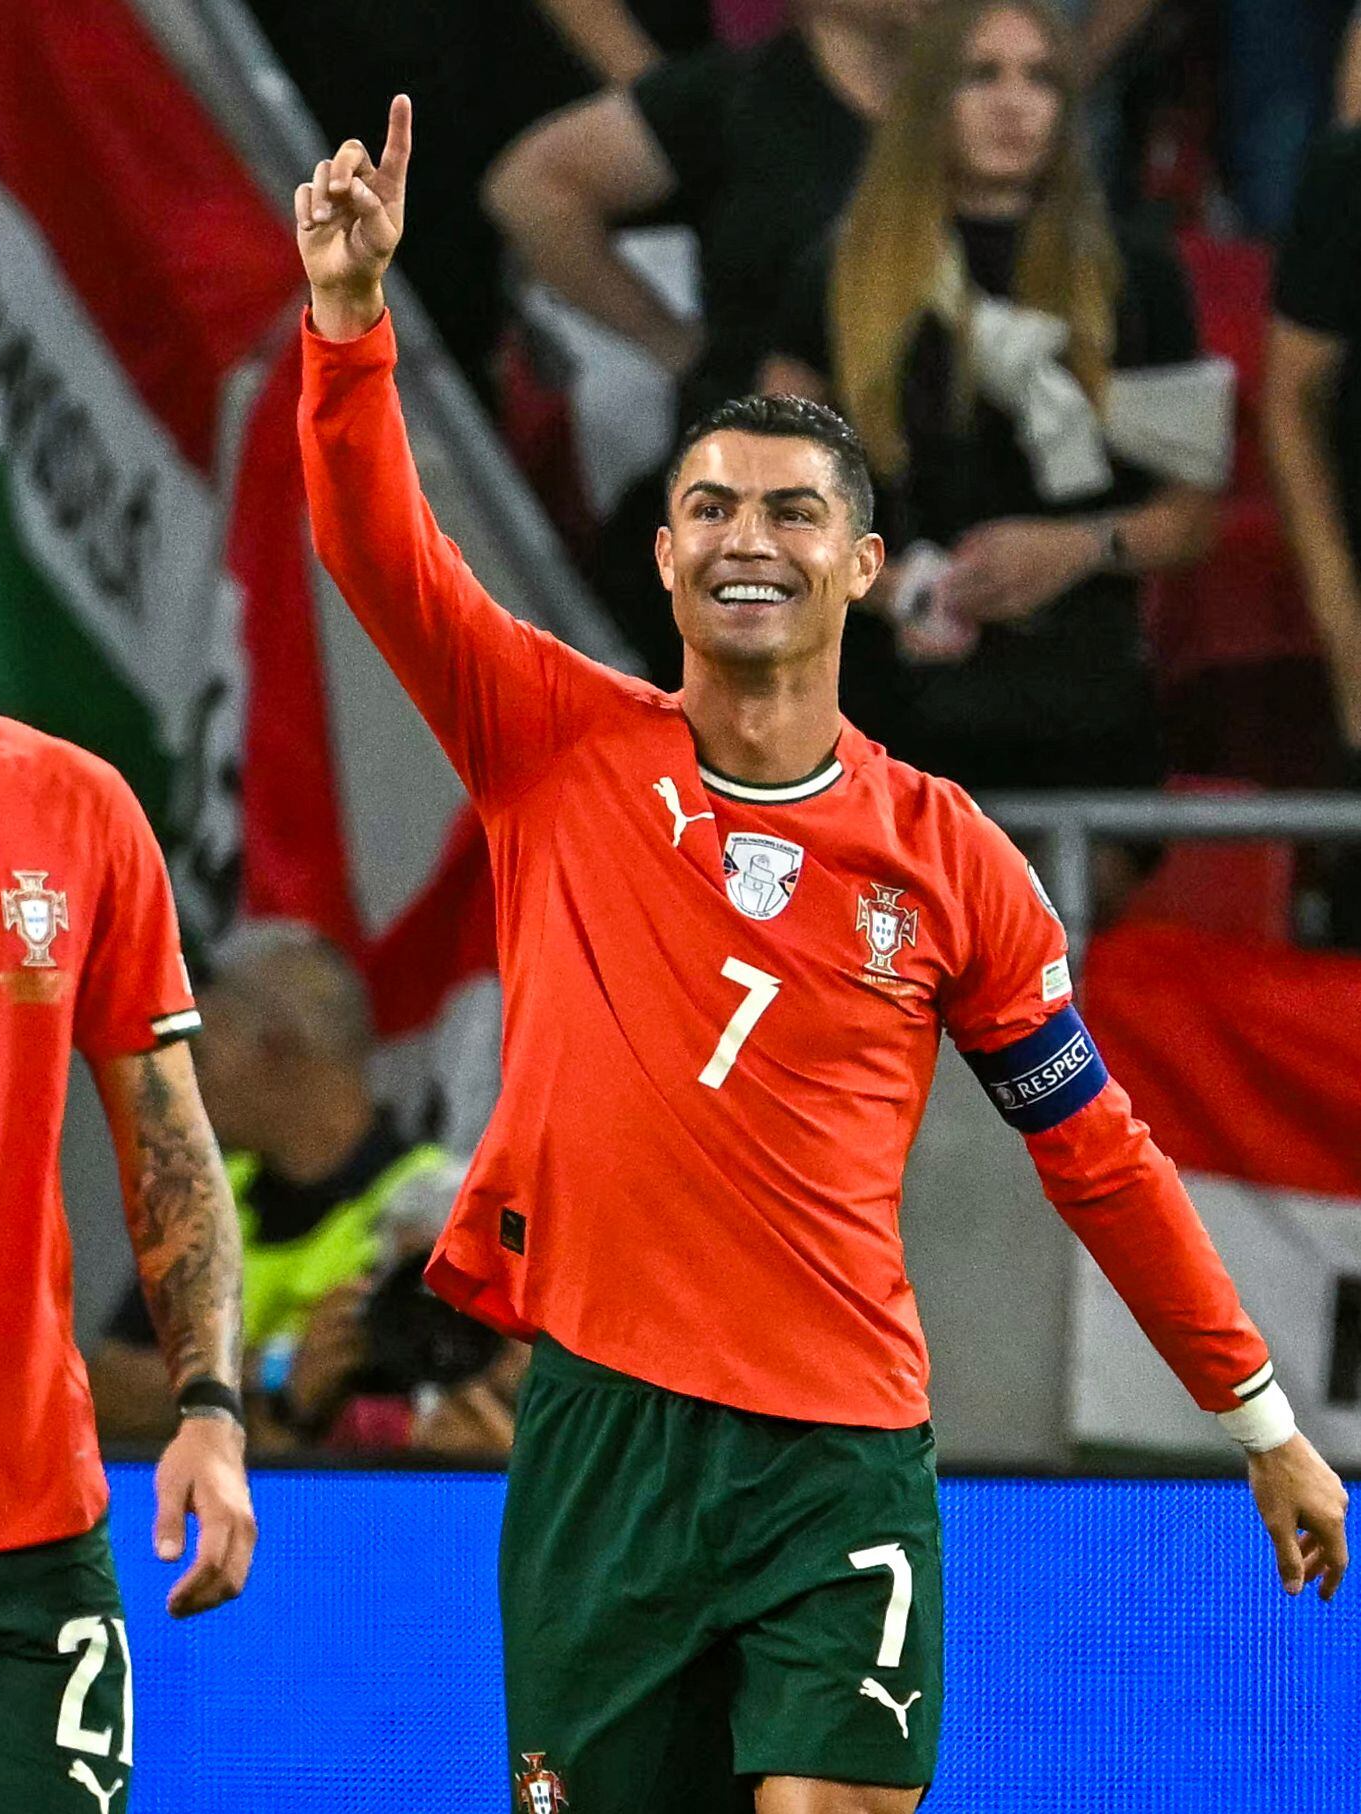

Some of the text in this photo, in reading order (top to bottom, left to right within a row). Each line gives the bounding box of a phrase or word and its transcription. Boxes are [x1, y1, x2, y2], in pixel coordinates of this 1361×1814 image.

[698, 956, 783, 1090] 7
[1017, 1036, 1089, 1099] RESPECT
[848, 1543, 913, 1668] 7
[56, 1615, 134, 1767] 21
